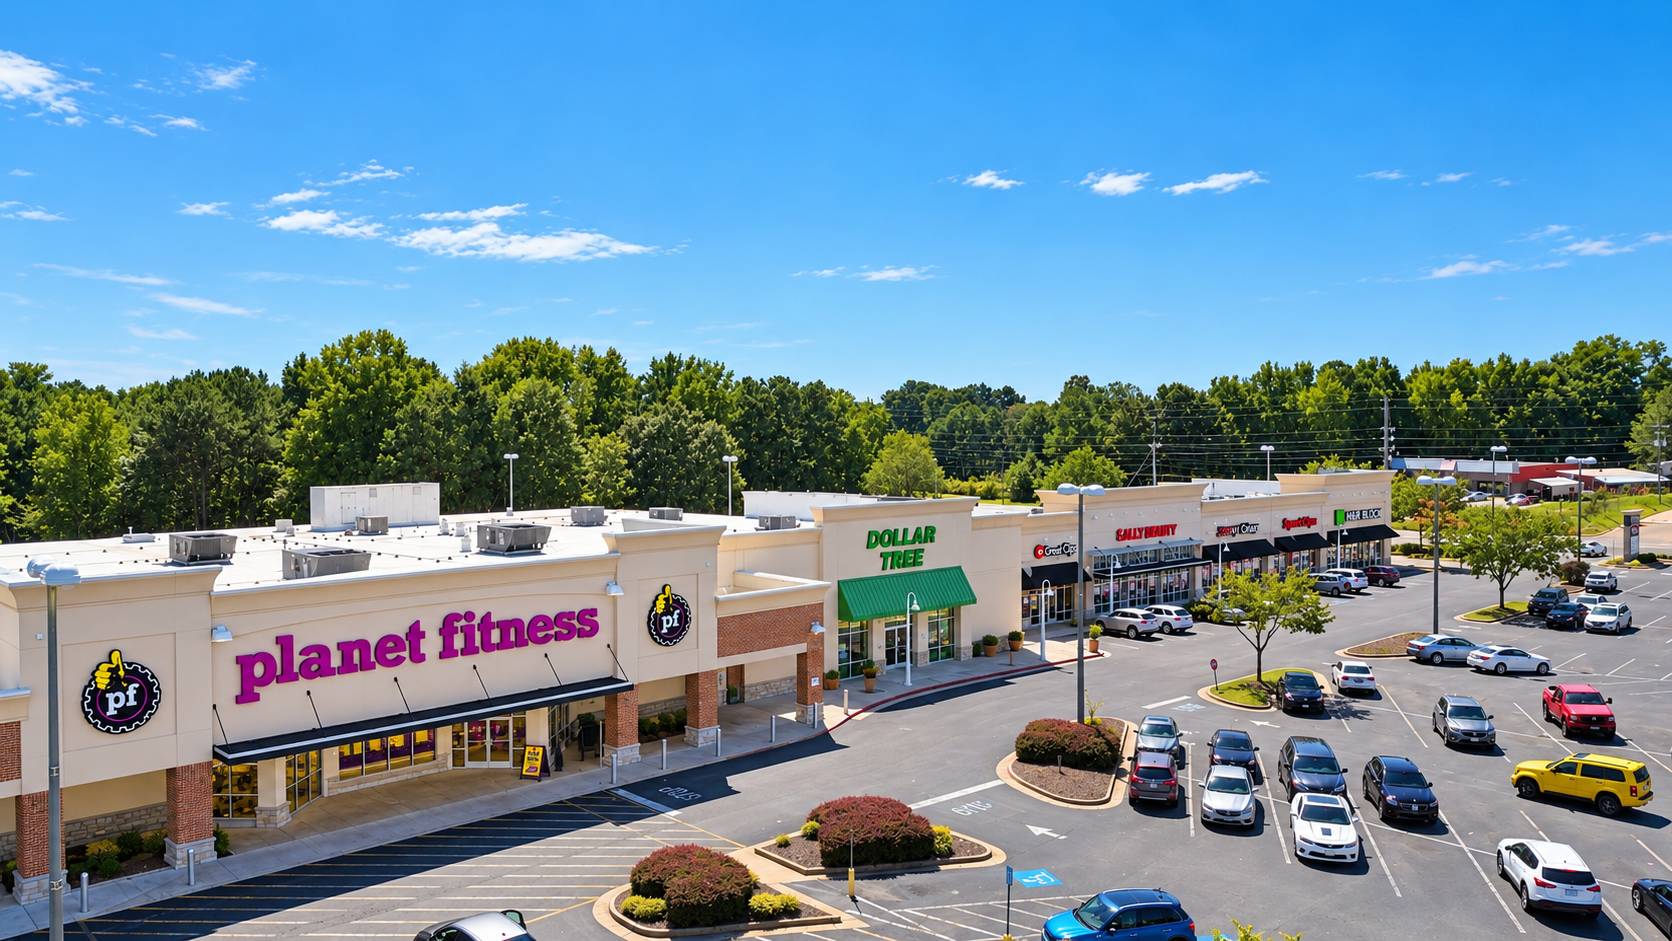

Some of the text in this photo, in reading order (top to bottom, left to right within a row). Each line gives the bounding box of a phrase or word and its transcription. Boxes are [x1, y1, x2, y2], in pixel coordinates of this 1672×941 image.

[866, 526, 936, 549] DOLLAR
[1116, 527, 1143, 541] SALLY
[880, 548, 925, 571] TREE
[661, 609, 680, 633] pf
[235, 608, 600, 704] planet fitness
[105, 683, 140, 716] pf
